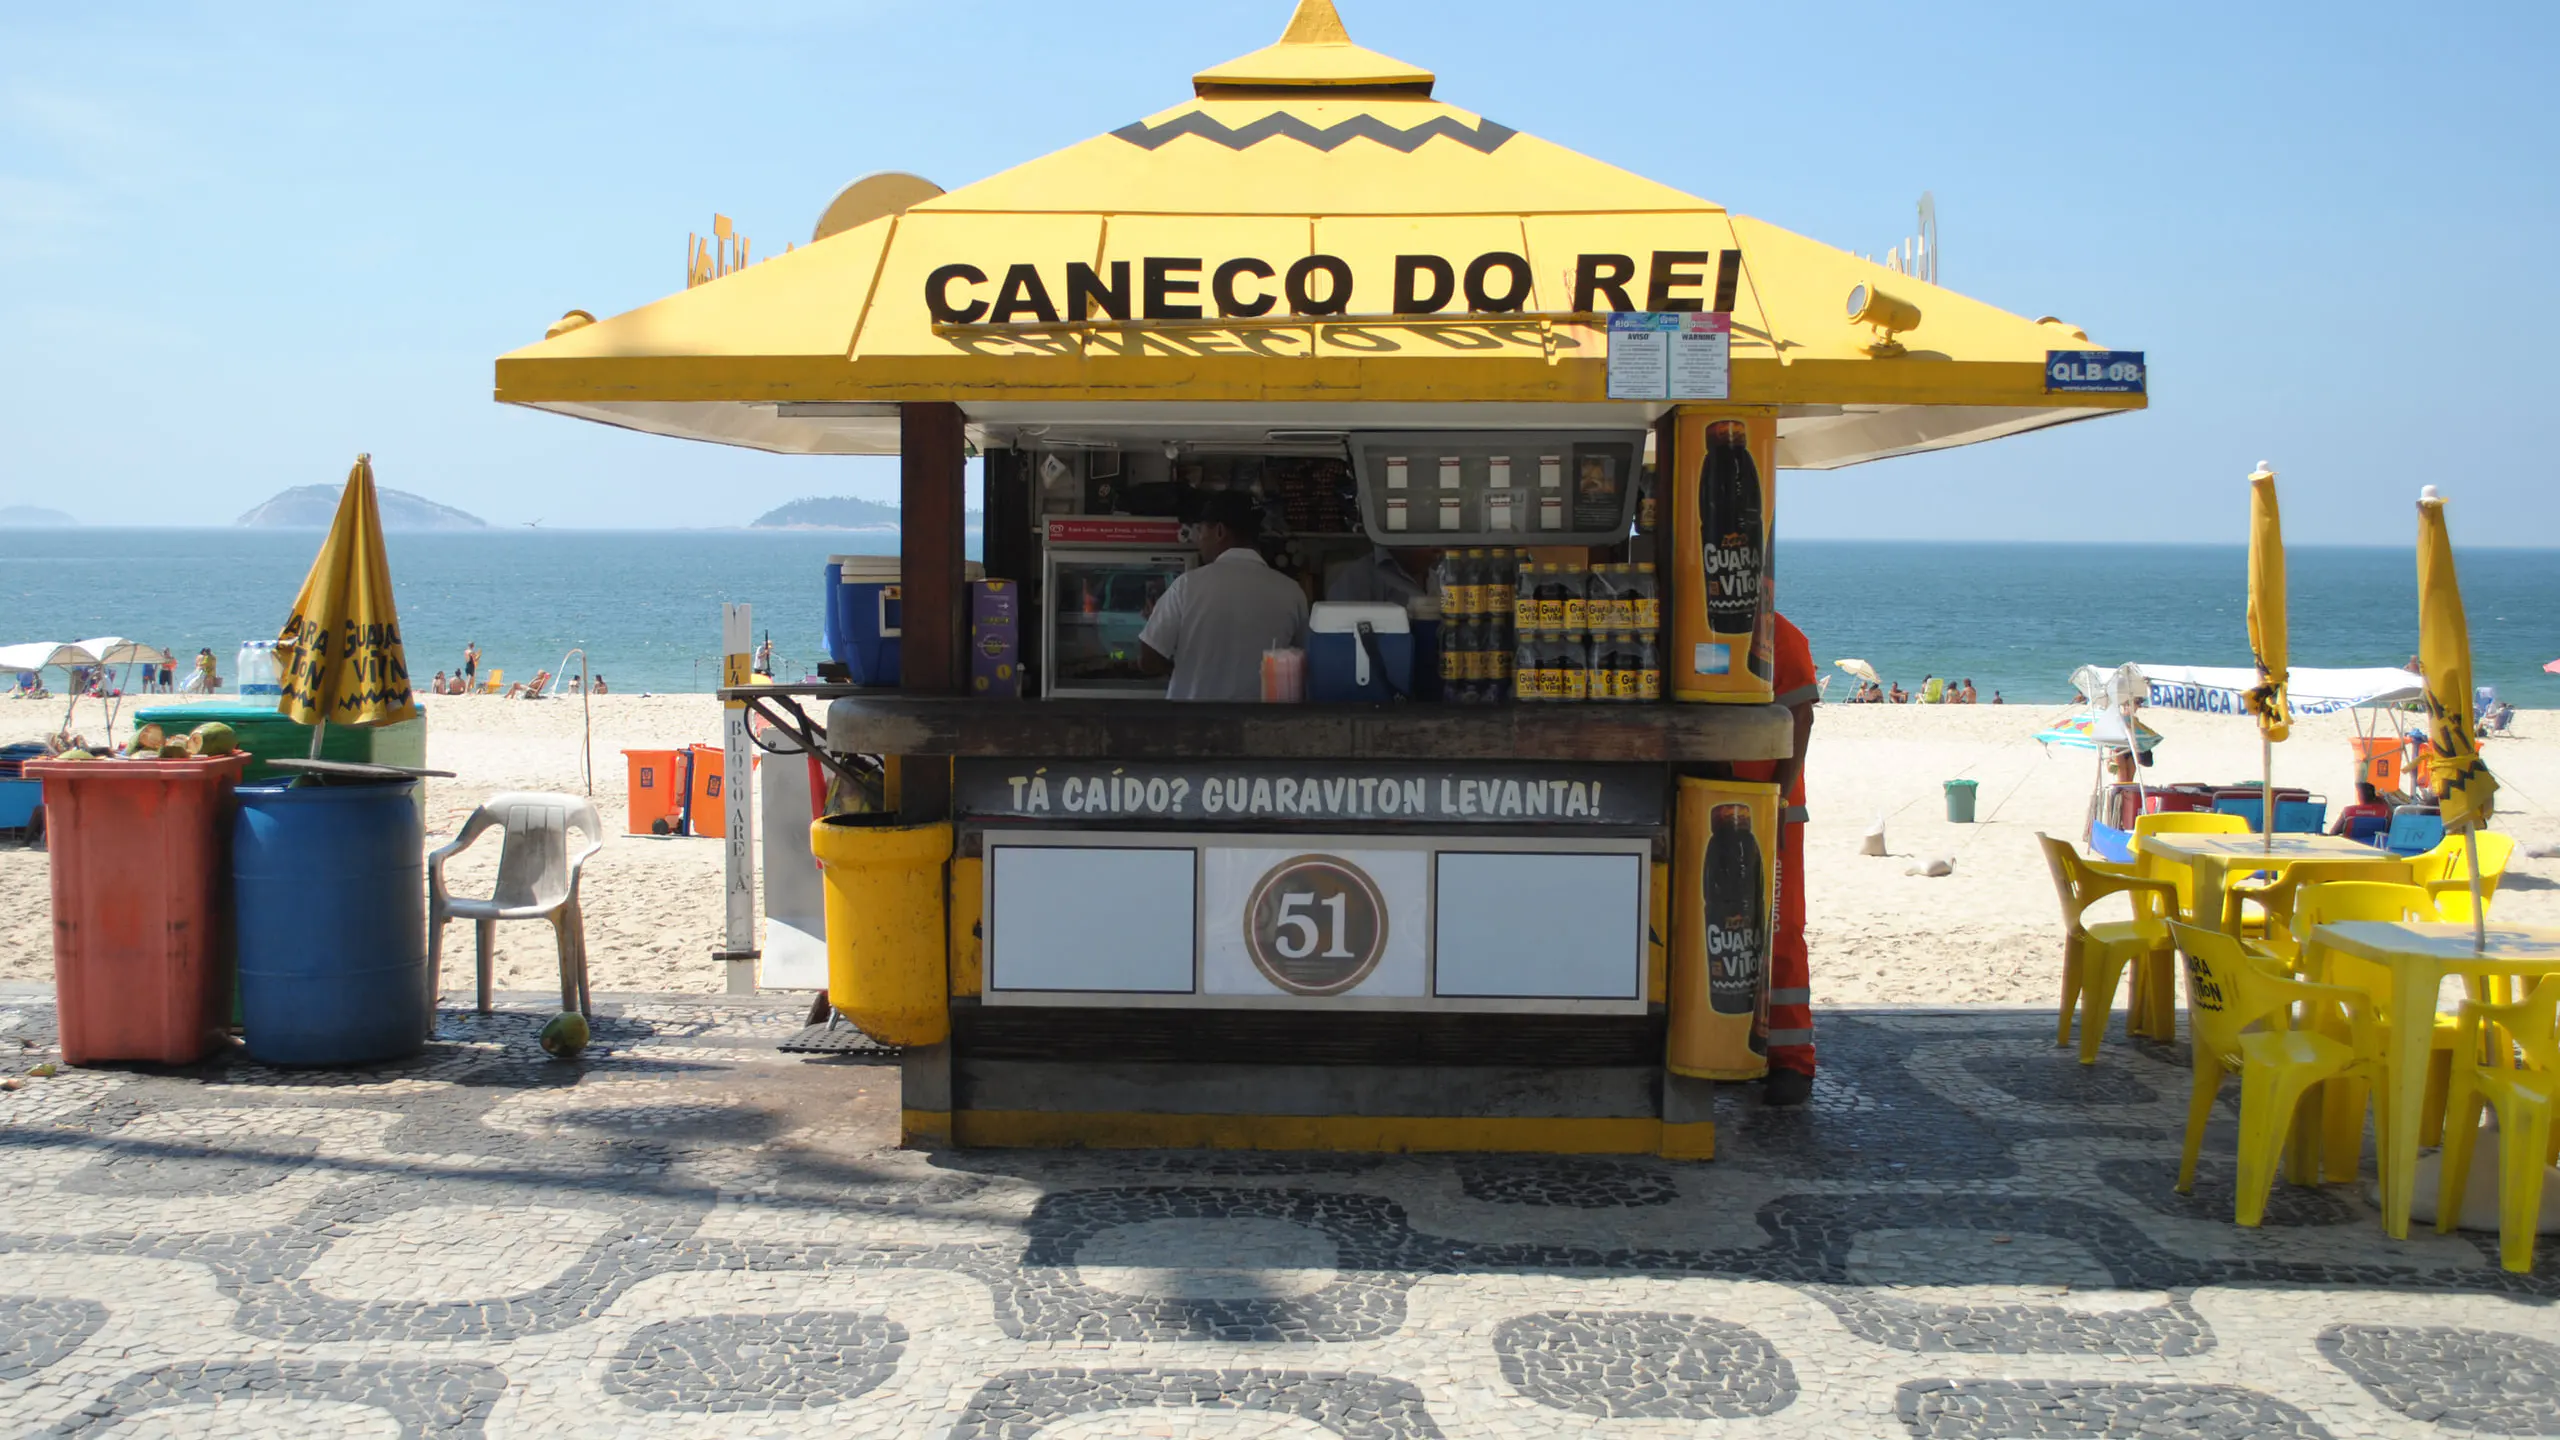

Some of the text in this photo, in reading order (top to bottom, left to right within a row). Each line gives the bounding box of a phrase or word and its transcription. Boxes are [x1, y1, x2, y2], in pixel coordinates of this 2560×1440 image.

[925, 250, 1742, 325] CANECO DO REI
[1627, 333, 1650, 341] AVISO
[1682, 333, 1716, 341] WARNING
[2052, 363, 2138, 382] QLB 08
[2151, 683, 2232, 715] BARRACA
[1008, 767, 1602, 817] TÁ CAÍDO? GUARAVITON LEVANTA!
[1275, 891, 1356, 958] 51
